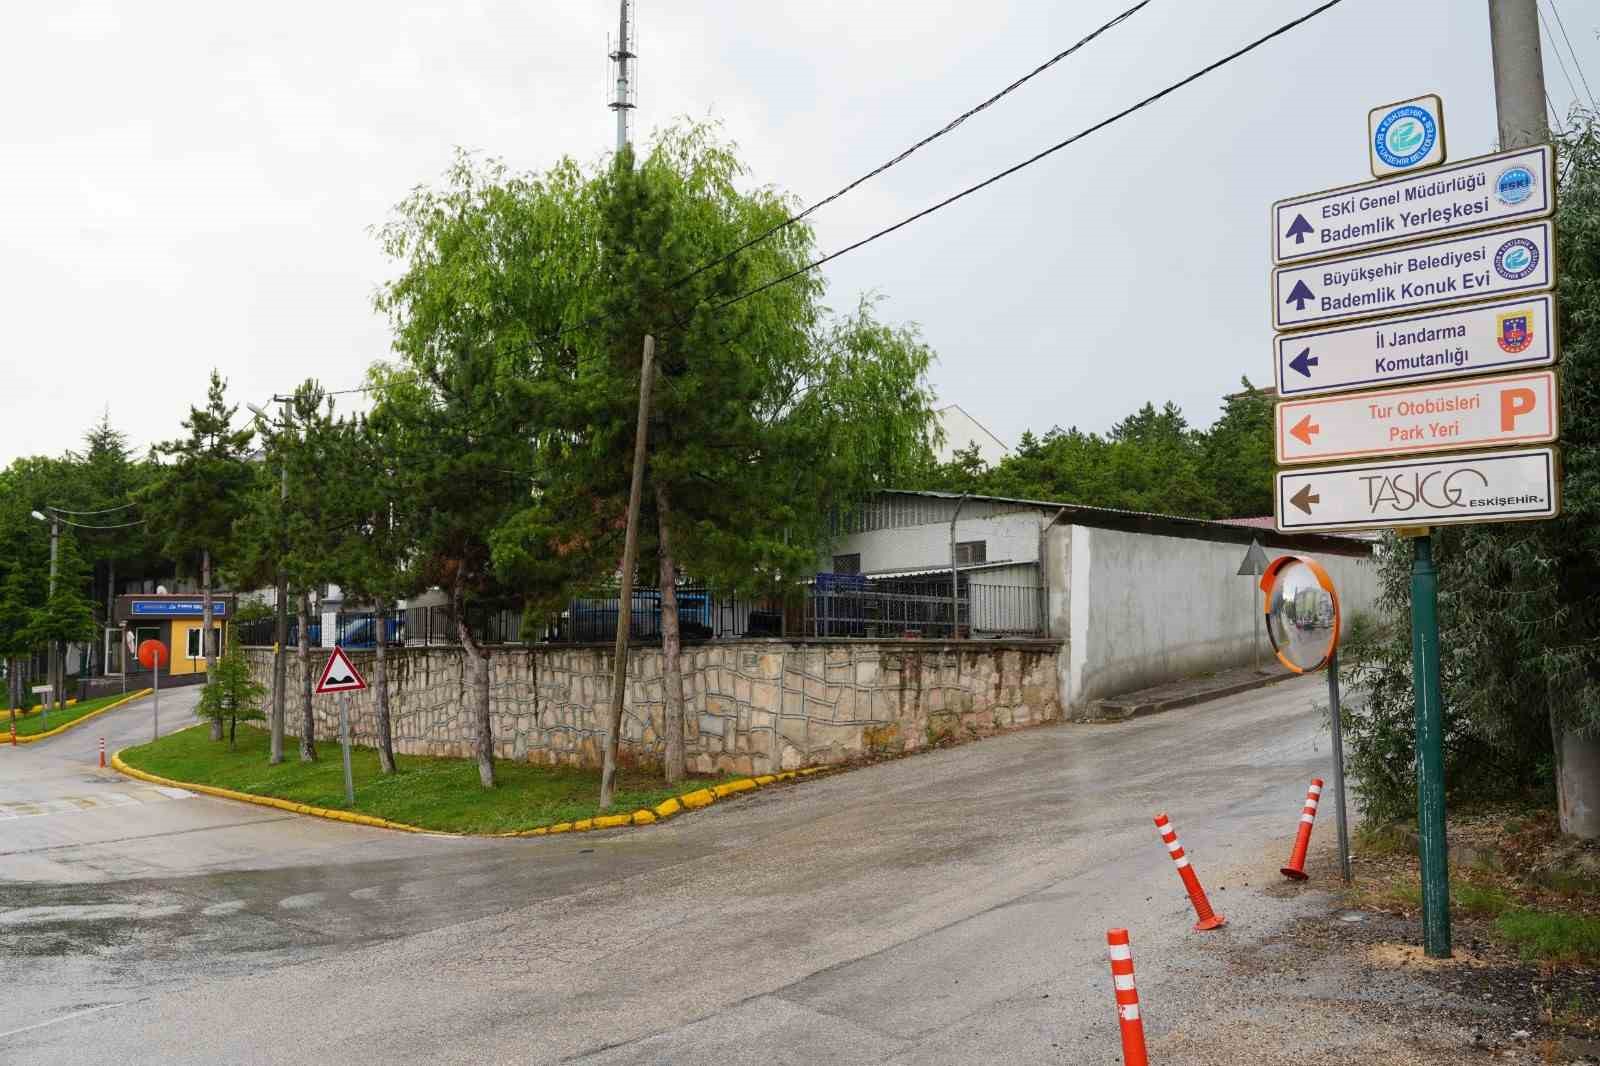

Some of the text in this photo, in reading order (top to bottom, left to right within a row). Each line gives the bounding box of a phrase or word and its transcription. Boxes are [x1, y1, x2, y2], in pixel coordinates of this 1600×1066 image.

[1322, 173, 1486, 218] ESKİ Genel Müdürlüğü
[1321, 197, 1489, 243] Bademlik Yerleşkesi
[1323, 262, 1403, 287] Büyükşehir
[1408, 246, 1486, 272] Belediyesi
[1321, 270, 1490, 311] Bademlik Konuk Evi
[1376, 325, 1466, 349] İl Jandarma
[1375, 348, 1469, 373] Komutanlığı
[1368, 393, 1480, 419] Tur Otobüsleri
[1500, 388, 1536, 432] P
[1389, 420, 1460, 441] Park Yeri
